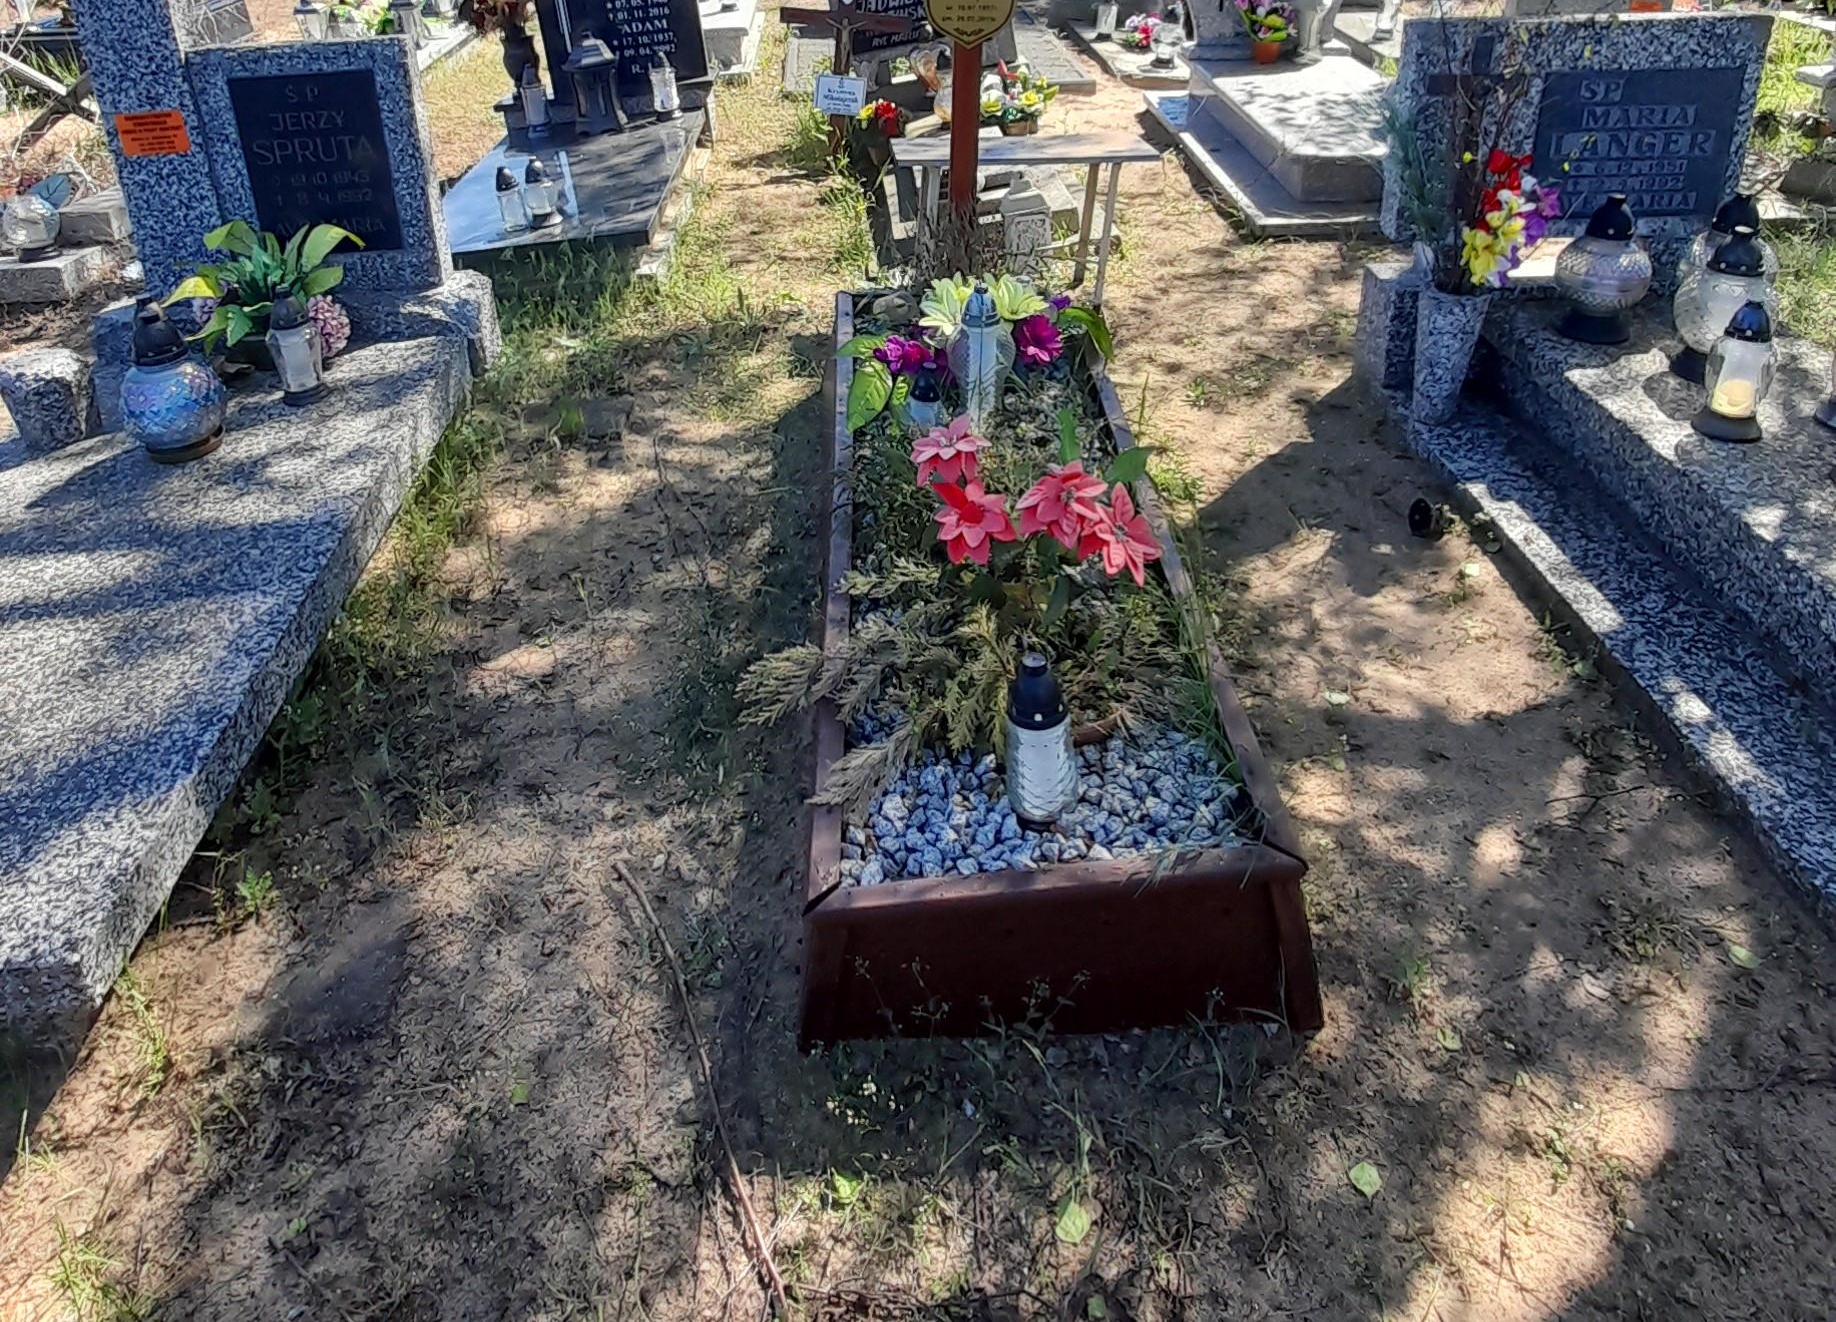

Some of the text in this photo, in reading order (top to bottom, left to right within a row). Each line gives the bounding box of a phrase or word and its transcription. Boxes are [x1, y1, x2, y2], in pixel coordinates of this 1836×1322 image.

[620, 18, 668, 35] ADAM
[269, 110, 345, 131] JERZY
[1585, 104, 1696, 127] MARIA
[252, 134, 376, 166] SPRUTA
[1553, 130, 1714, 158] LANGER
